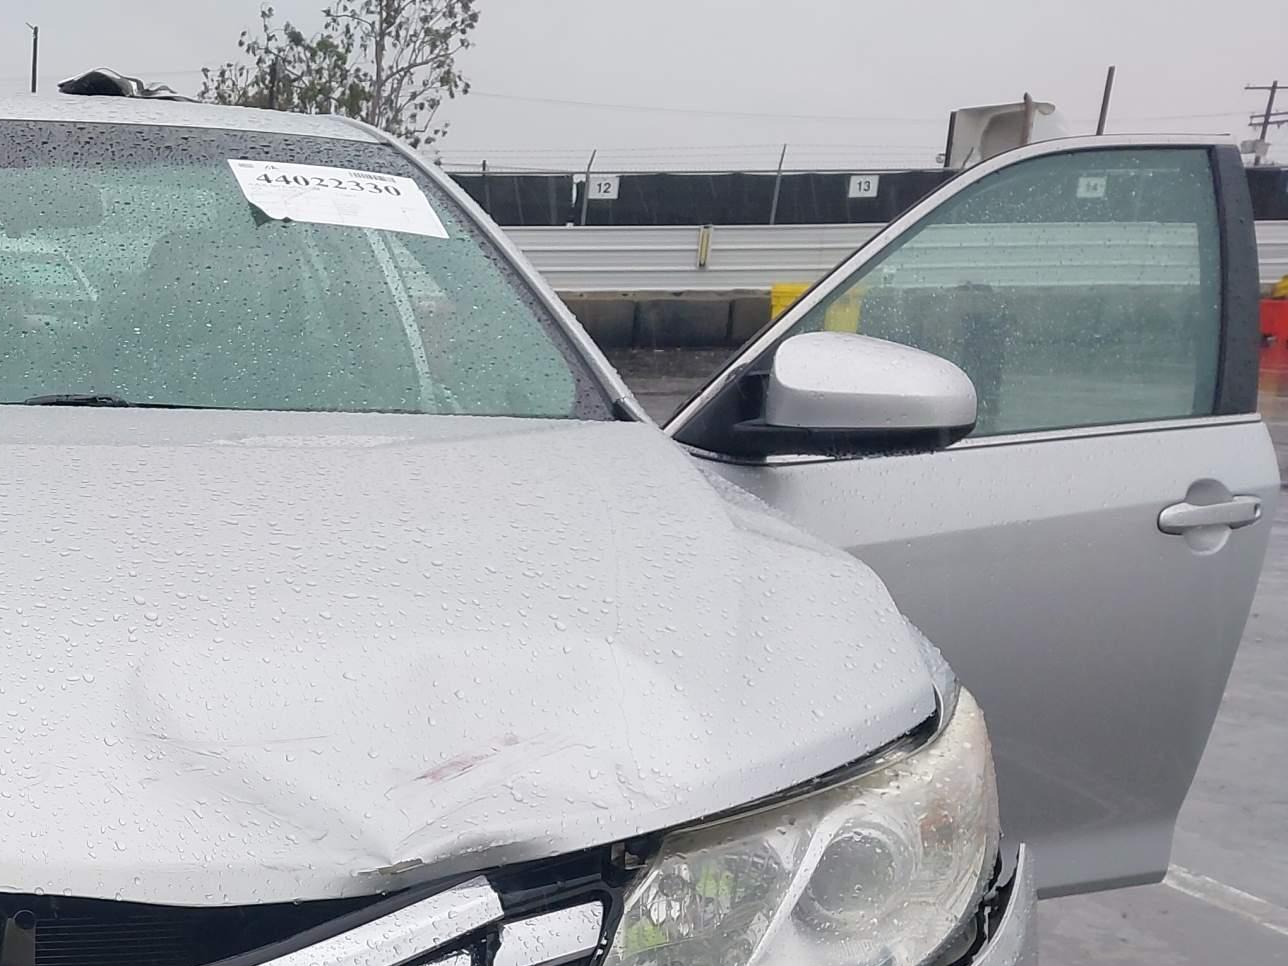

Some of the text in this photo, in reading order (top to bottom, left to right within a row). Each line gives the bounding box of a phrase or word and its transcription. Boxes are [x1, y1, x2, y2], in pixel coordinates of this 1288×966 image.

[255, 173, 401, 196] 44022330
[597, 182, 612, 193] 12
[857, 180, 871, 192] 13
